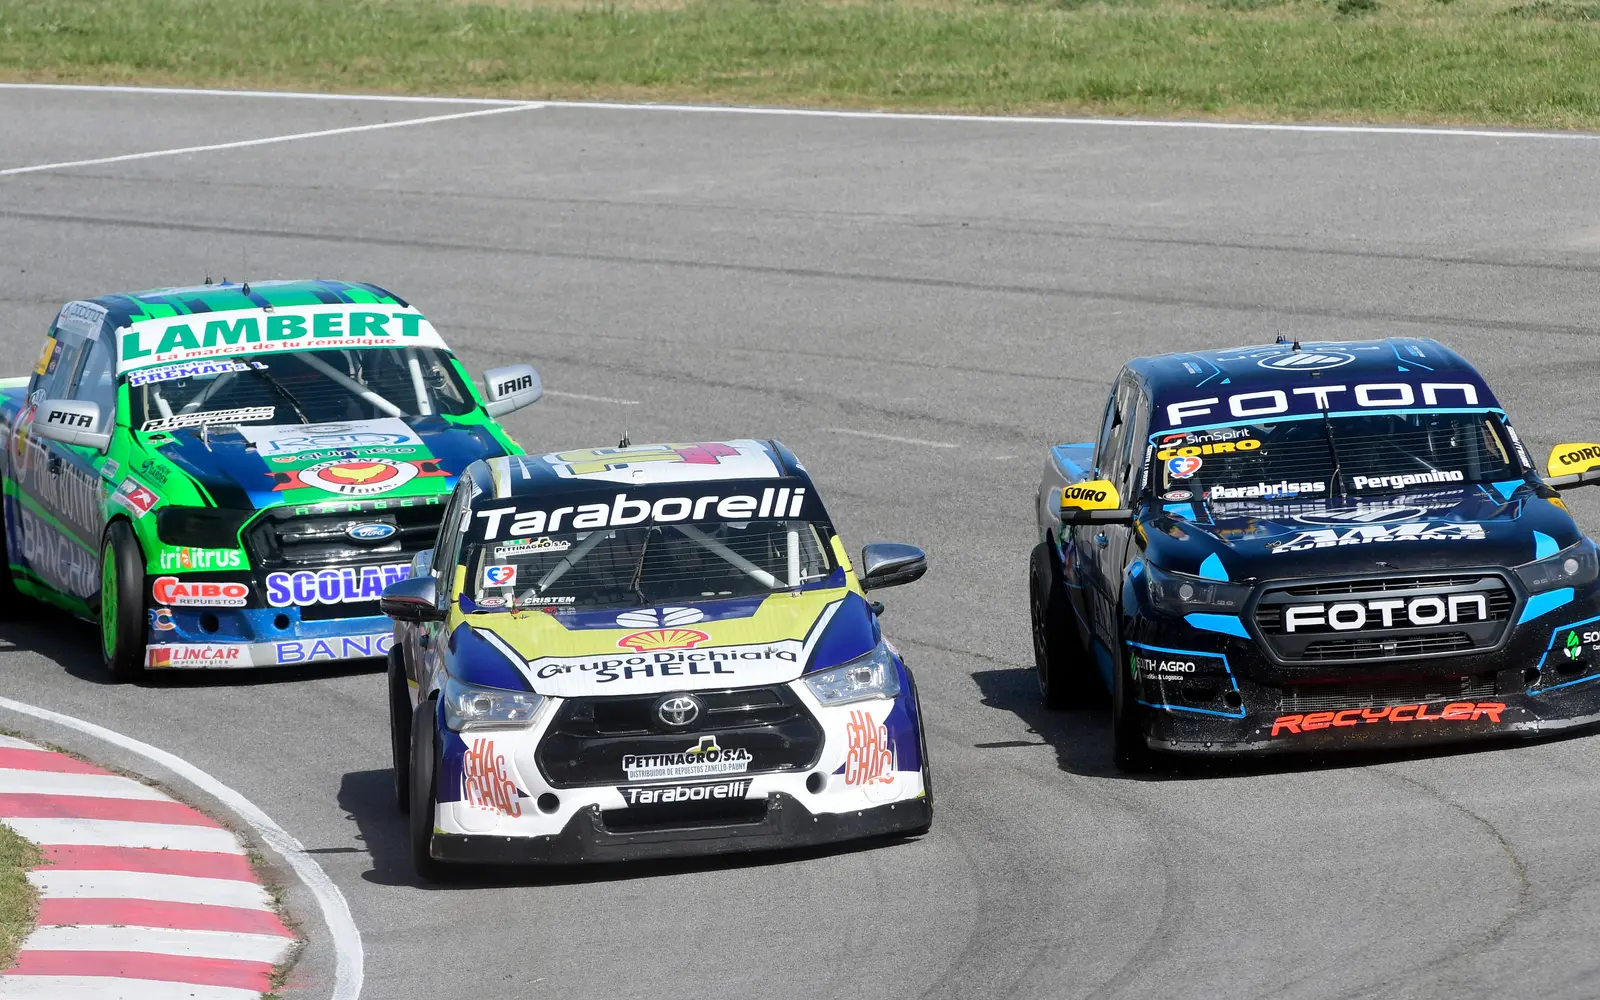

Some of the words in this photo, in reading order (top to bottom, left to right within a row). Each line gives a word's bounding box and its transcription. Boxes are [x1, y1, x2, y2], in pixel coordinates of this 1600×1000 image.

[123, 312, 427, 361] LAMBERT
[156, 353, 178, 361] La
[186, 346, 245, 358] marca
[283, 340, 301, 348] tu
[307, 337, 396, 346] remolque
[130, 361, 212, 377] Transportes
[132, 363, 232, 385] PREMAT
[1167, 383, 1478, 425] FOTON
[48, 411, 93, 428] PITA
[1186, 428, 1250, 444] SimSpirit
[1157, 439, 1261, 460] COIRO
[1211, 480, 1325, 500] Parabrisas
[1353, 470, 1464, 490] Pergamino
[1064, 487, 1106, 502] COIRO
[295, 497, 439, 515] RANGER
[476, 488, 806, 540] Taraborelli
[359, 527, 385, 537] Ford
[496, 541, 551, 553] PETTINAGRO
[153, 578, 247, 604] CAIBO
[1285, 595, 1487, 632] FOTON
[173, 648, 240, 660] LINCAR
[537, 656, 646, 679] Grupo
[653, 650, 797, 664] Dichiara
[596, 661, 735, 683] SHELL
[1159, 661, 1196, 673] AGRO
[846, 710, 886, 752] CHAC
[465, 738, 507, 782] CHAC
[624, 751, 719, 769] PETTINAGRO
[722, 749, 752, 762] S.A.
[630, 769, 666, 779] DISTRIBUIDOR
[667, 767, 675, 776] DE
[675, 765, 704, 775] REPUESTOS
[704, 762, 747, 773] ZANELLO-PAUNY
[628, 781, 745, 803] Taraborelli
